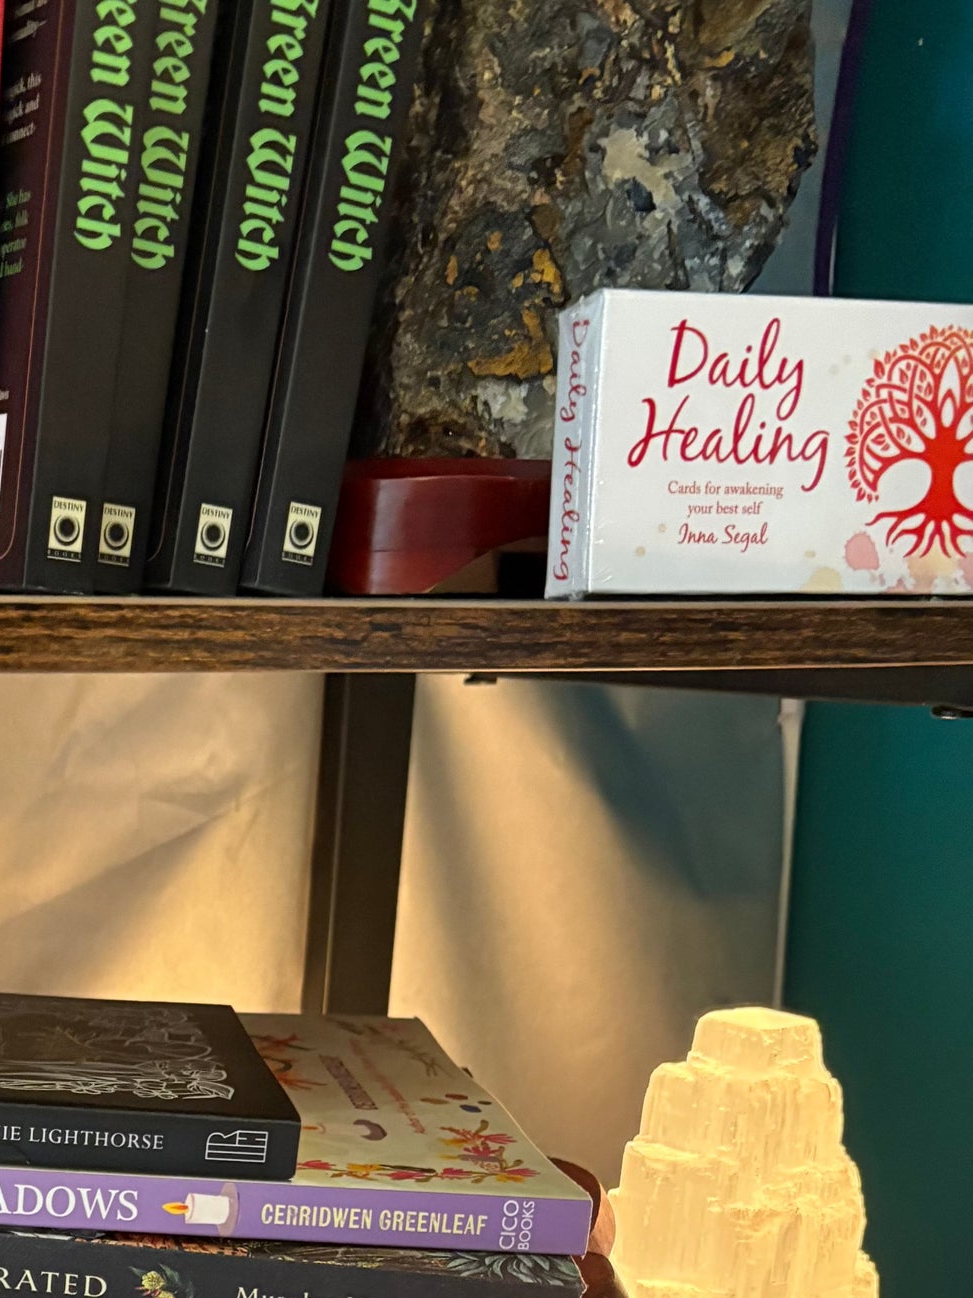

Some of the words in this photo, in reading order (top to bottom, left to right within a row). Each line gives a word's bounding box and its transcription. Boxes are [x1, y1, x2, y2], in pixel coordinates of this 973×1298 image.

[90, 0, 137, 87] een
[74, 99, 134, 250] Witch
[131, 126, 190, 270] Witch
[235, 128, 297, 271] Witch
[328, 130, 393, 271] Witch
[560, 319, 590, 422] Daily
[667, 317, 804, 421] Daily
[627, 393, 830, 492] Healing
[53, 500, 84, 512] DESTINY
[103, 506, 134, 519] DESTINY
[201, 507, 231, 519] DESTINY
[290, 506, 319, 518] DESTINY
[553, 437, 583, 581] Healing
[667, 480, 701, 495] Cards
[704, 480, 722, 495] for
[724, 481, 784, 499] awakening
[687, 503, 713, 518] your
[716, 501, 739, 515] best
[741, 501, 764, 515] self
[678, 523, 718, 544] Inna
[722, 522, 768, 553] Segal
[29, 1127, 165, 1150] LIGHTHORSE
[260, 1202, 374, 1232] CERRIDWEN
[378, 1209, 490, 1236] GREENLEAF
[499, 1200, 519, 1250] CICO
[518, 1201, 535, 1250] BOOKS
